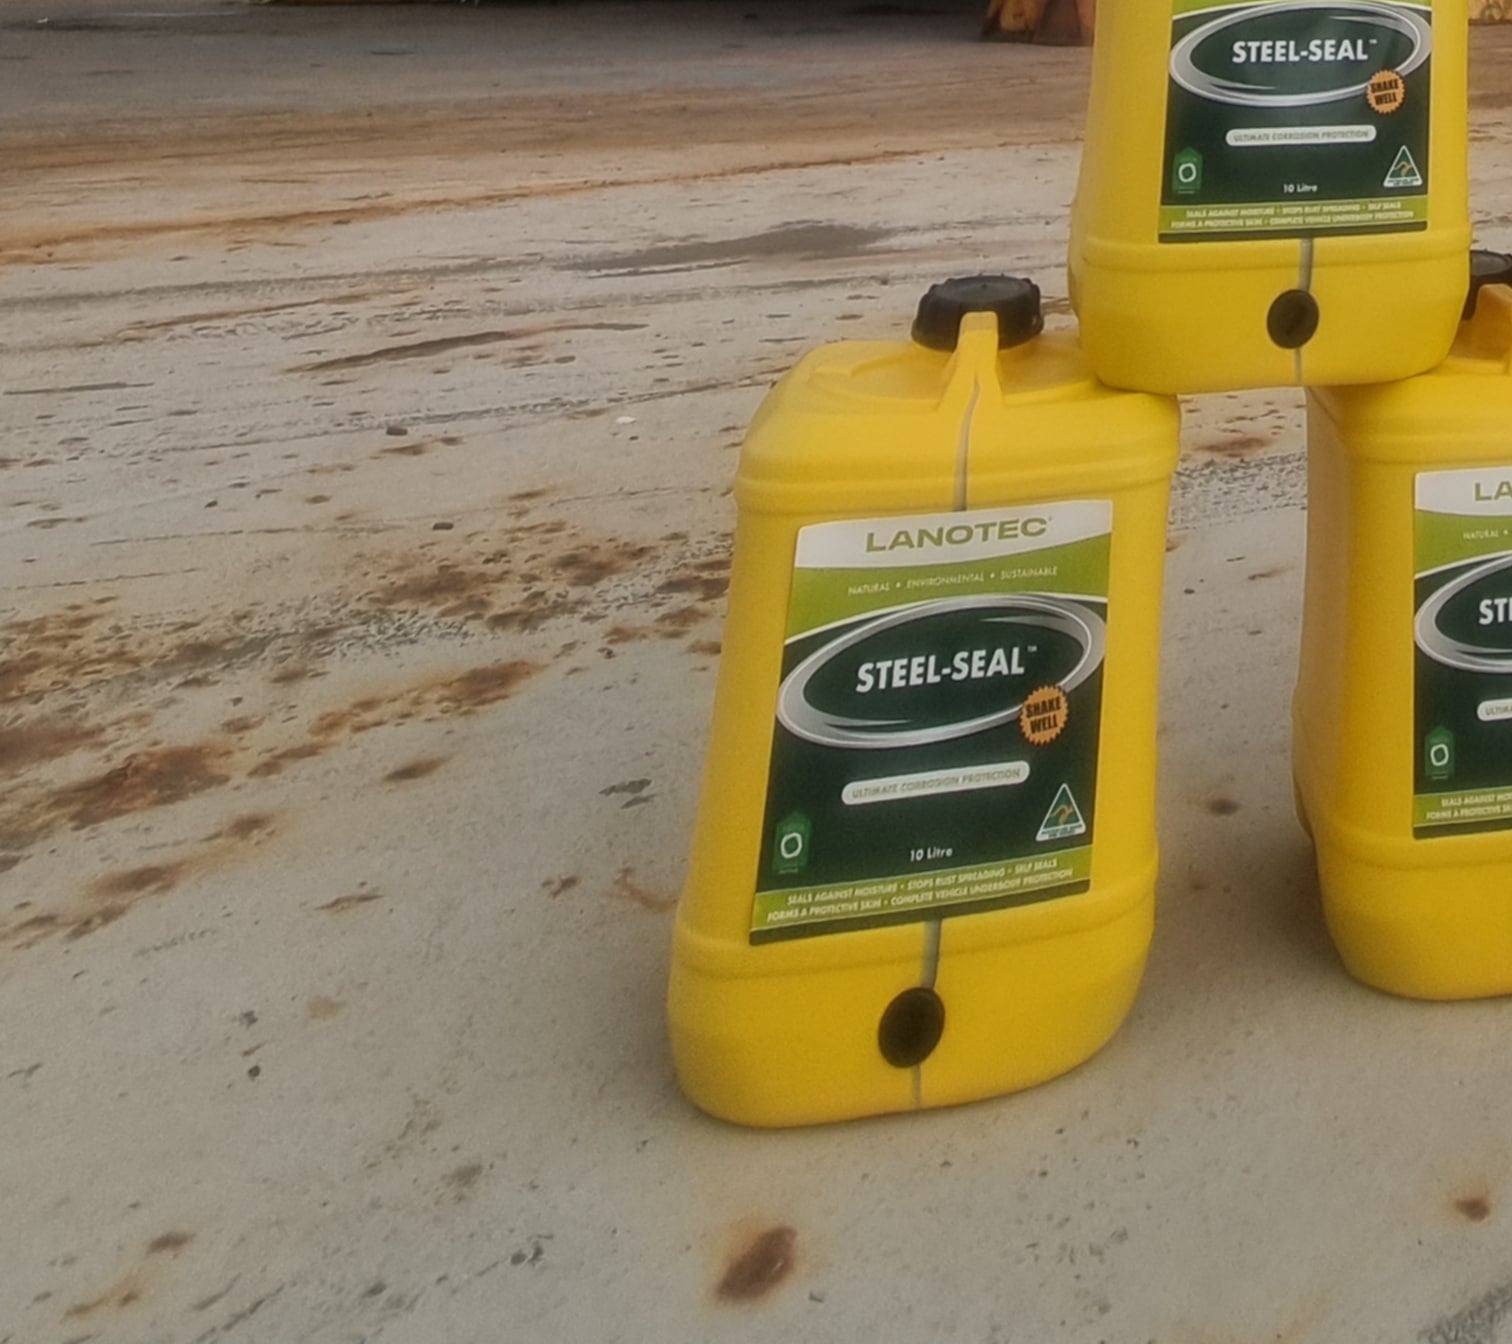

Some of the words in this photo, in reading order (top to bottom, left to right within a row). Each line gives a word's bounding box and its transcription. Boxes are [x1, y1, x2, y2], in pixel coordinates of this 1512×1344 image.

[1370, 79, 1398, 93] SHAKE
[1375, 92, 1396, 105] WELL
[1282, 183, 1293, 193] 10
[1296, 183, 1317, 192] Litre
[865, 517, 1047, 552] LANOTEC
[848, 581, 890, 595] NATURAL
[906, 572, 984, 589] ENVIRONMENTAL
[1000, 565, 1057, 580] SUSTAINABLE
[1025, 696, 1061, 718] SHAKE
[1029, 713, 1058, 734] WELL
[851, 782, 897, 799] ULTIMATE
[961, 766, 1020, 785] PROTECTION
[909, 848, 923, 862] 10
[926, 844, 953, 860] Litre
